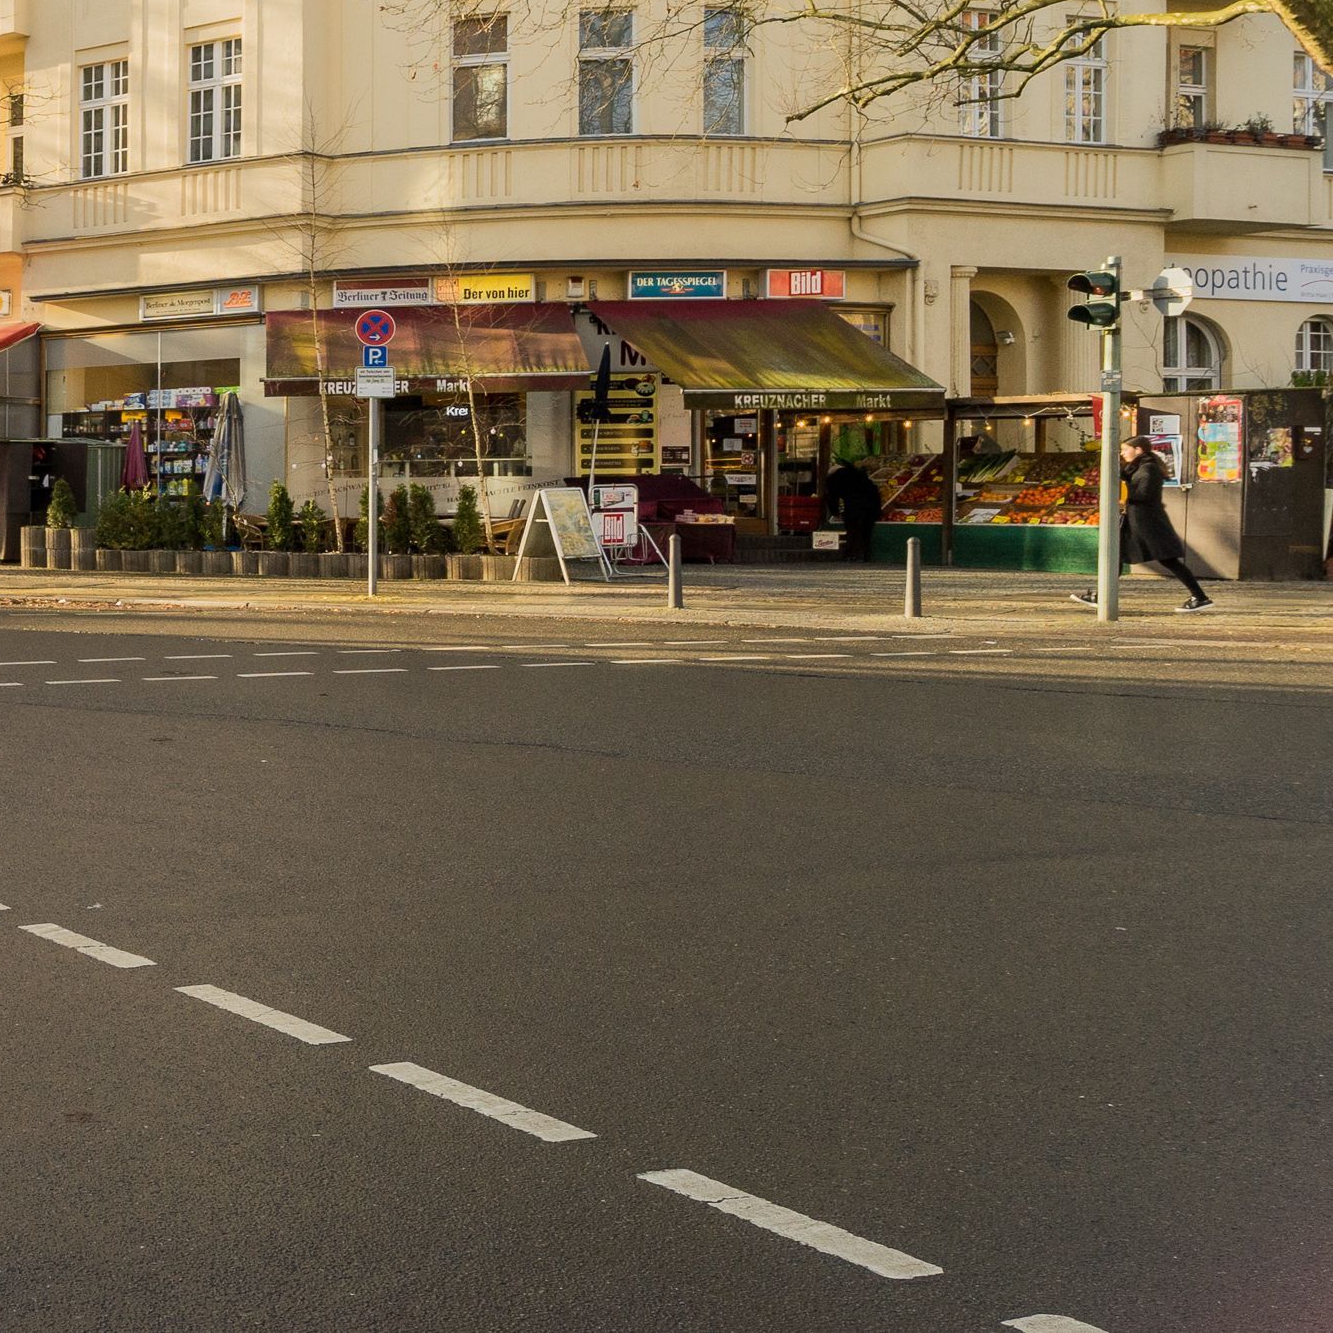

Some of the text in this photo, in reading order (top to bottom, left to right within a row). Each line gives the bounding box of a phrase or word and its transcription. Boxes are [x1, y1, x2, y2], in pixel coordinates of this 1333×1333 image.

[636, 276, 717, 287] DER TAGESSPIEGEL
[789, 271, 822, 295] Bild
[337, 290, 428, 302] Berliner Zeitung
[463, 288, 483, 300] Der
[486, 290, 505, 300] von
[507, 286, 530, 299] hier
[368, 348, 382, 365] P
[734, 394, 892, 410] KREUZNACHER Markt
[603, 515, 624, 541] Bild
